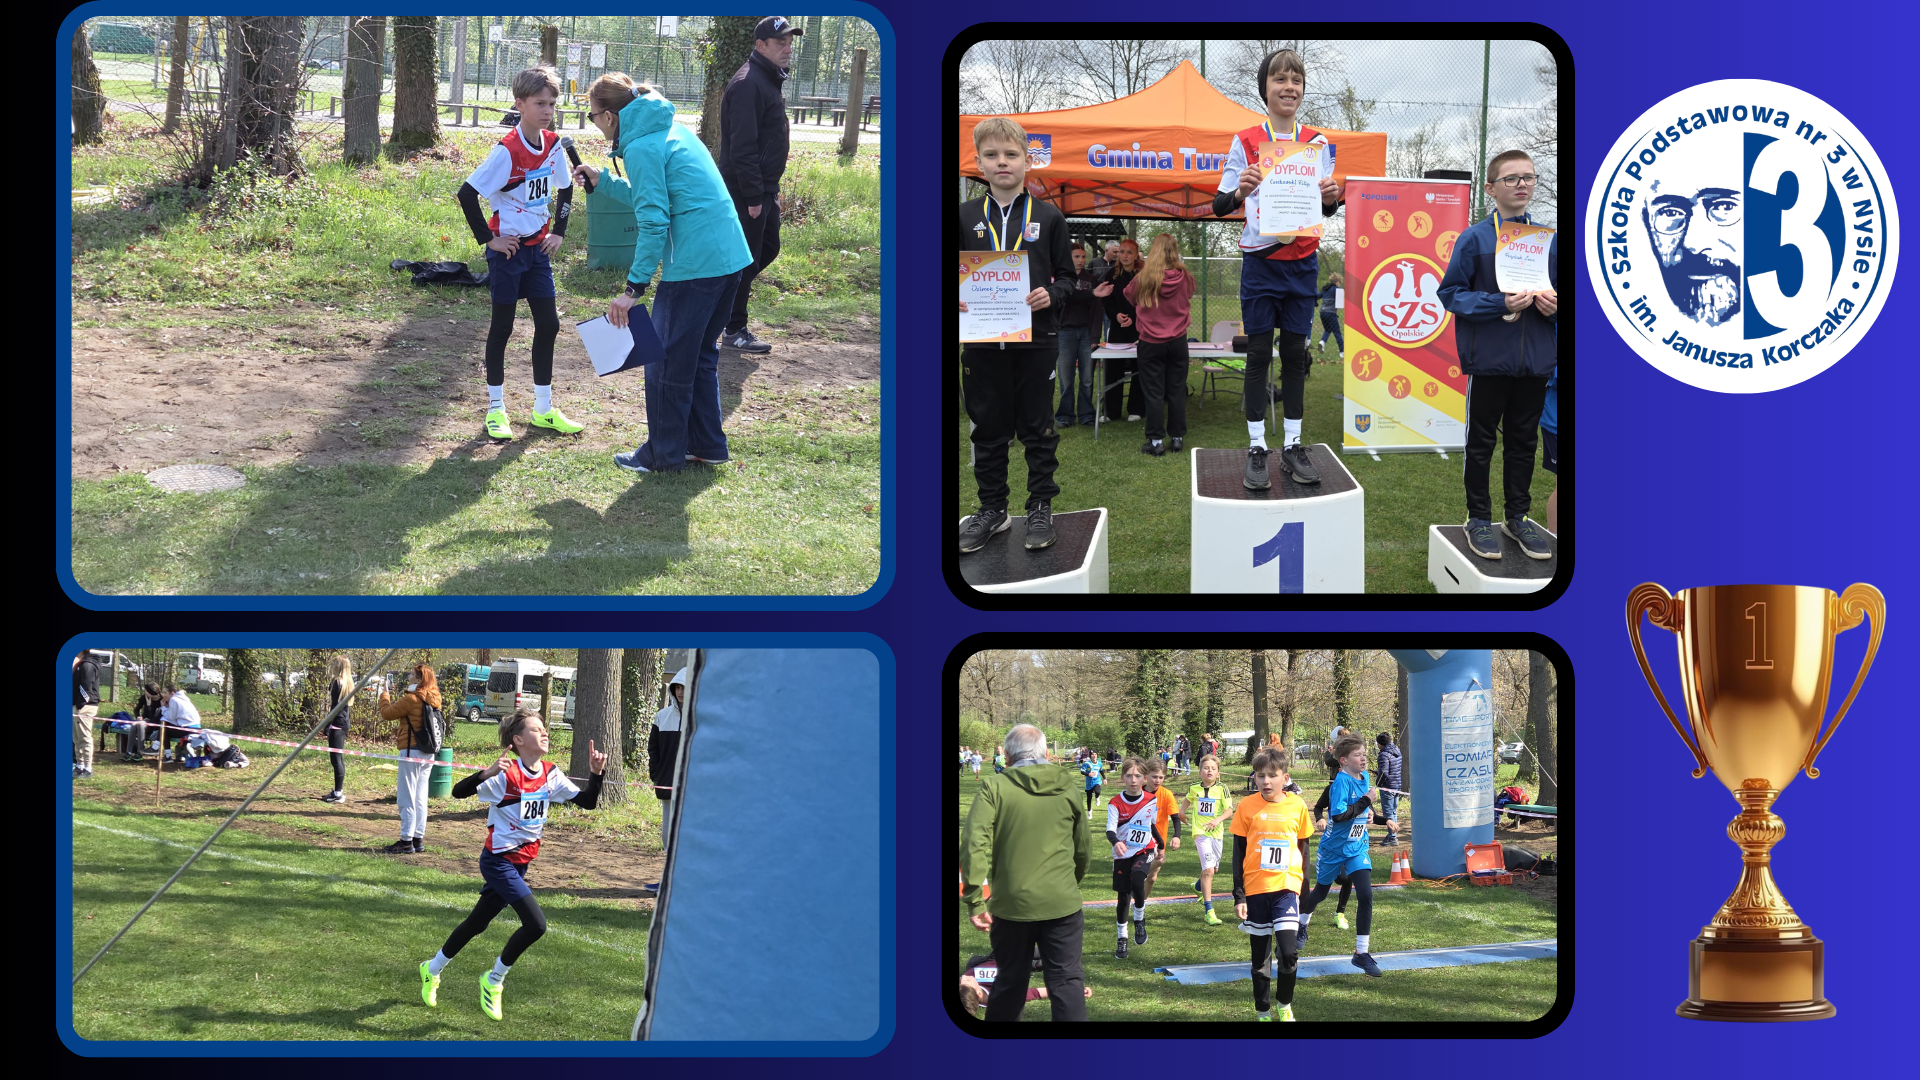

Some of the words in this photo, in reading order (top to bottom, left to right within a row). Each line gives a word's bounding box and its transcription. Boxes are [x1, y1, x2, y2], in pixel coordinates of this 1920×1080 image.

[1087, 142, 1174, 170] Gmina
[1274, 164, 1316, 177] DYPLOM
[529, 176, 548, 201] 284
[1365, 193, 1398, 201] OPOLSKIE
[976, 230, 984, 238] 10
[1509, 241, 1544, 255] DYPLOM
[972, 271, 1021, 282] DYPLOM
[1380, 302, 1439, 329] SZS
[1391, 329, 1425, 339] Opolskie
[1253, 521, 1305, 594] 1
[1744, 601, 1775, 670] 1
[524, 800, 544, 820] 284
[1200, 801, 1213, 813] 281
[1130, 830, 1146, 844] 287
[1269, 847, 1282, 864] 70
